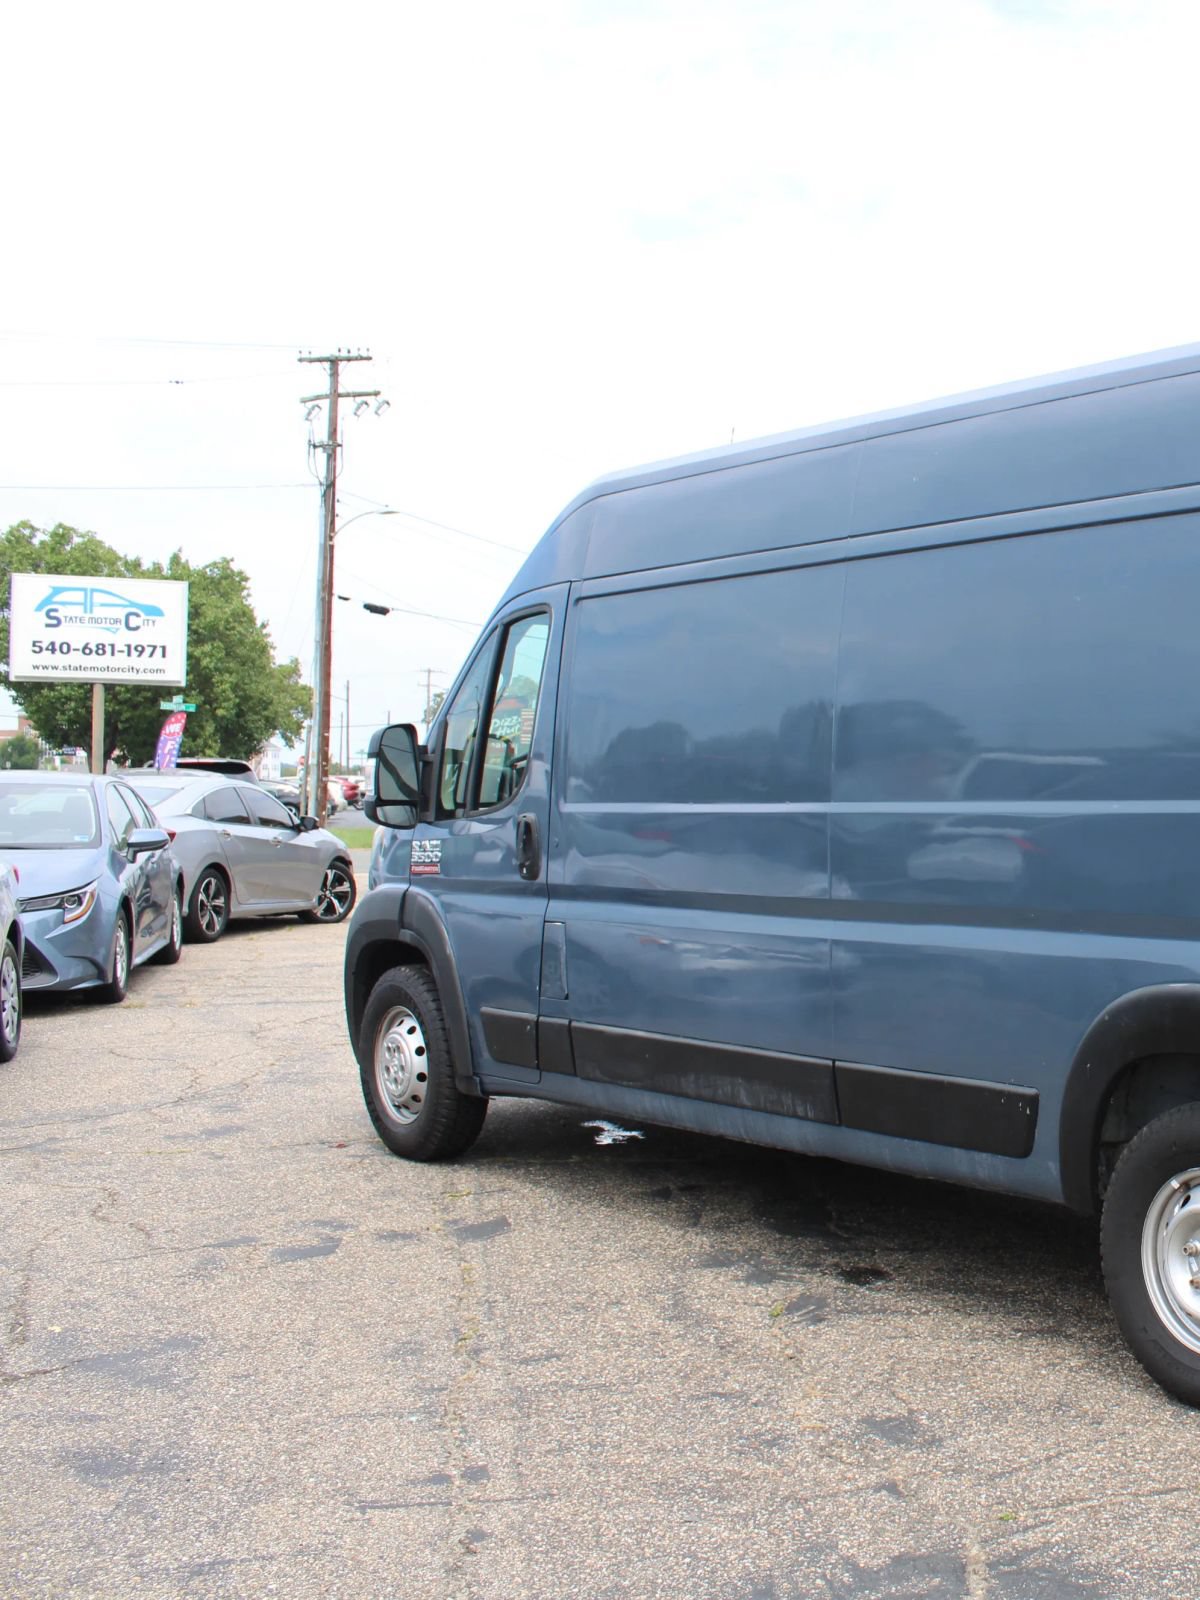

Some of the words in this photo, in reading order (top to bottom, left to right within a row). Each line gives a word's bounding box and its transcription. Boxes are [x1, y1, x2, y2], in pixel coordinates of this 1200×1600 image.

[45, 608, 86, 628] STATE
[88, 616, 122, 626] MOTOR
[125, 612, 156, 631] CITY
[31, 640, 167, 659] 540-681-1971
[32, 663, 165, 675] www.statemotorcity.com
